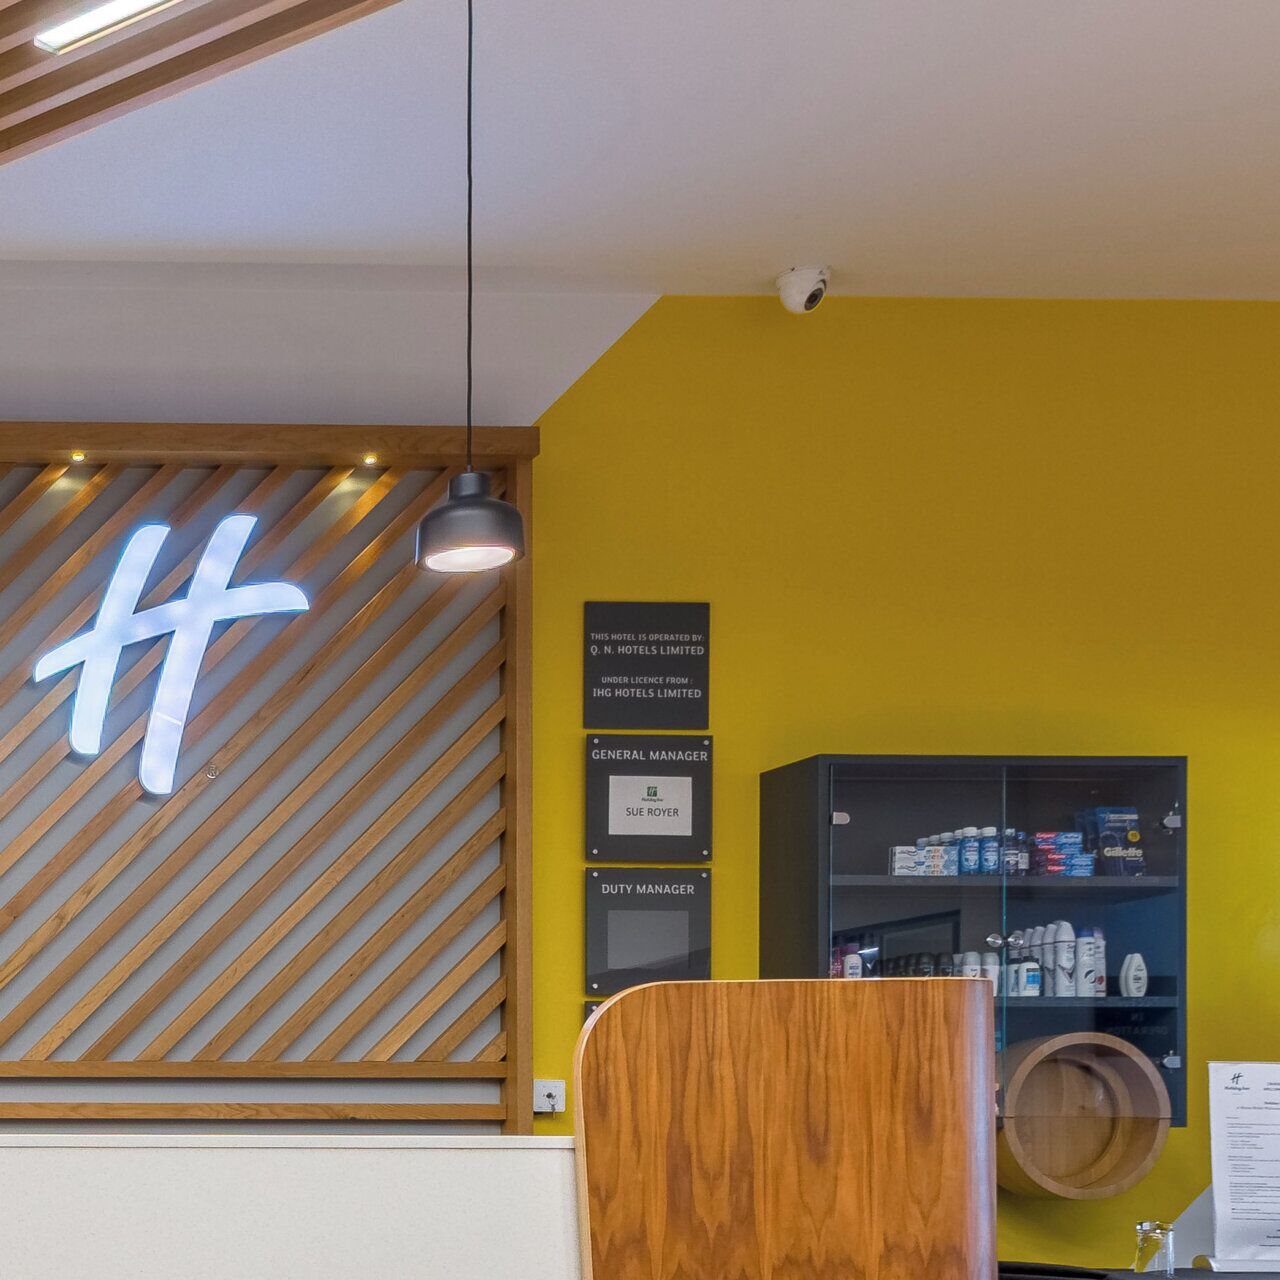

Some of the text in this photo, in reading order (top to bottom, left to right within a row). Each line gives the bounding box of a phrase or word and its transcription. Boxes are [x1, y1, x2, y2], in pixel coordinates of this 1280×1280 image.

[590, 633, 609, 641] THIS
[649, 634, 690, 642] OPERATED
[590, 645, 704, 656] Q. N. HOTELS LIMITED
[631, 677, 664, 685] LICENCE
[593, 688, 702, 698] IHG HOTELS LIMITED
[592, 749, 708, 761] GENERAL MANAGER
[626, 807, 679, 817] SUE ROYER
[602, 884, 695, 895] DUTY MANAGER
